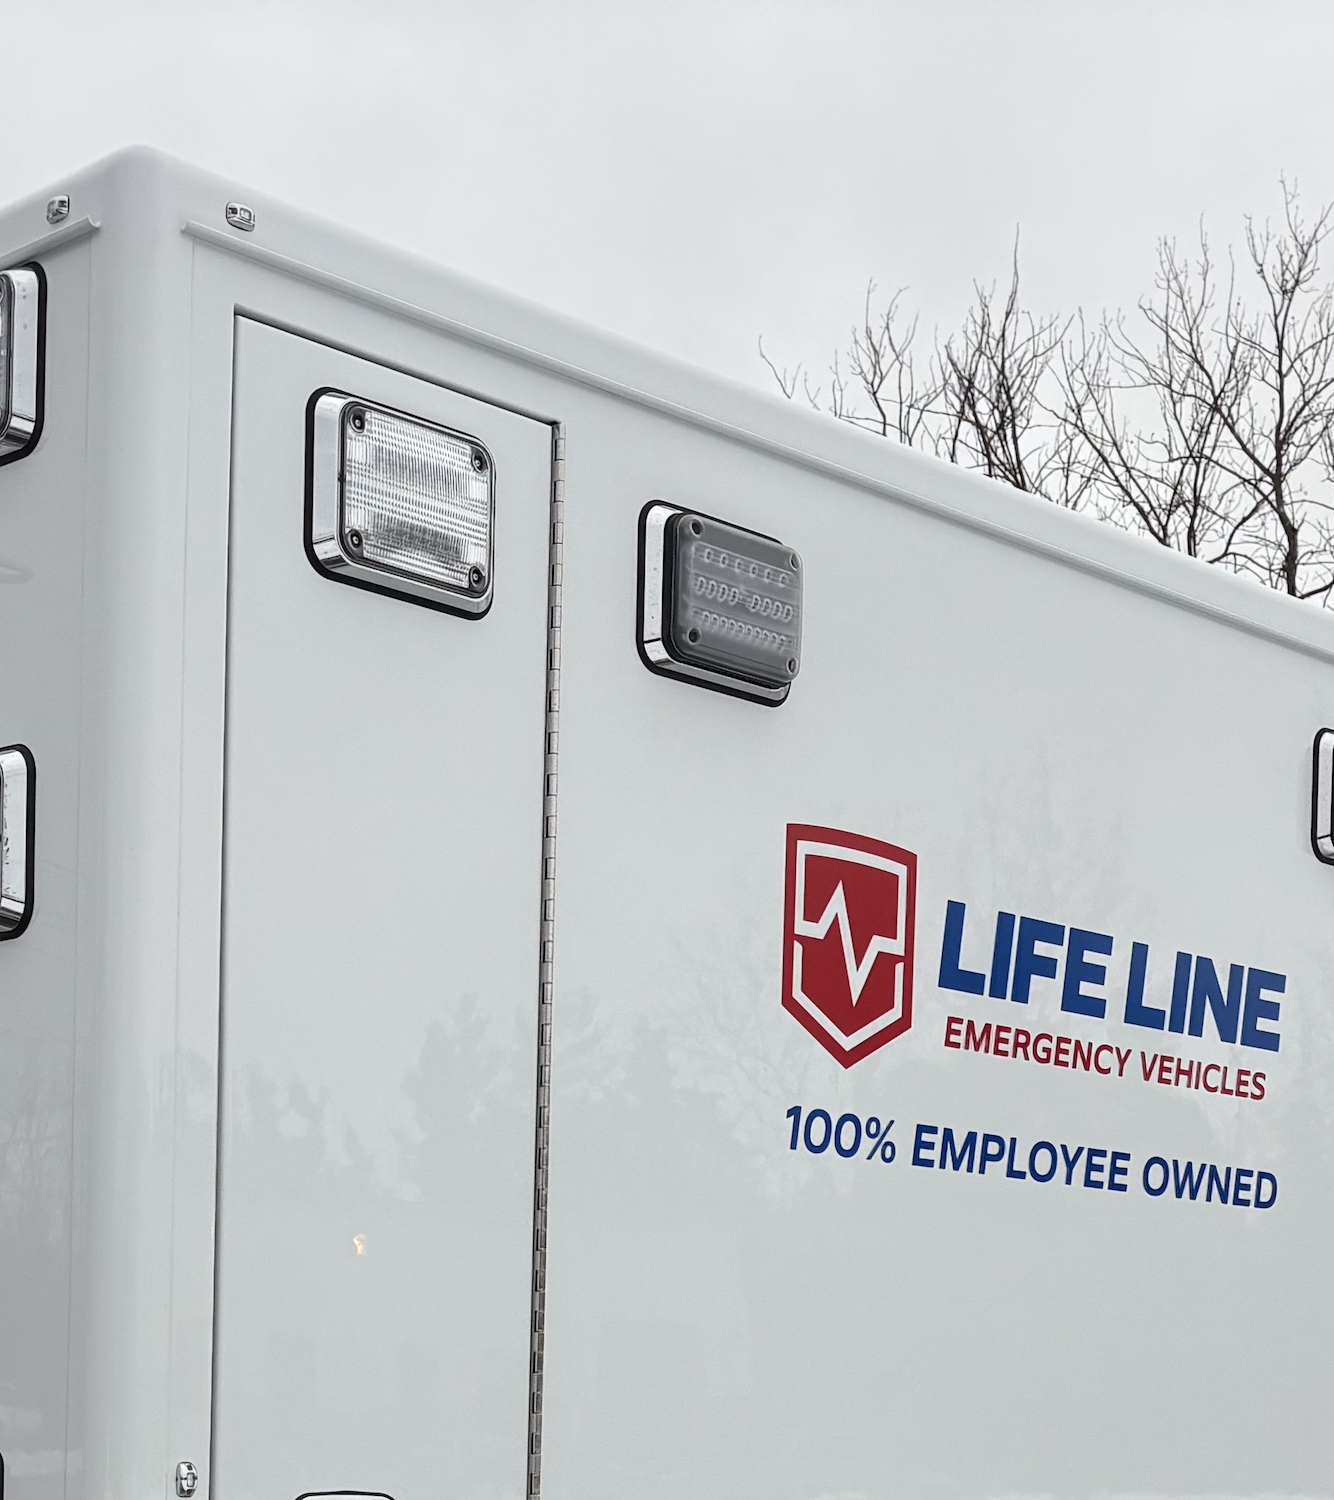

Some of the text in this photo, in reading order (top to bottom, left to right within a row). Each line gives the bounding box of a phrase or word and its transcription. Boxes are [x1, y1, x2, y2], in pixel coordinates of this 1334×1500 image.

[938, 900, 1287, 1052] LIFE LINE
[943, 1016, 1267, 1101] EMERGENCY VEHICLES
[786, 1106, 1279, 1209] 100% EMPLOYEE OWNED
